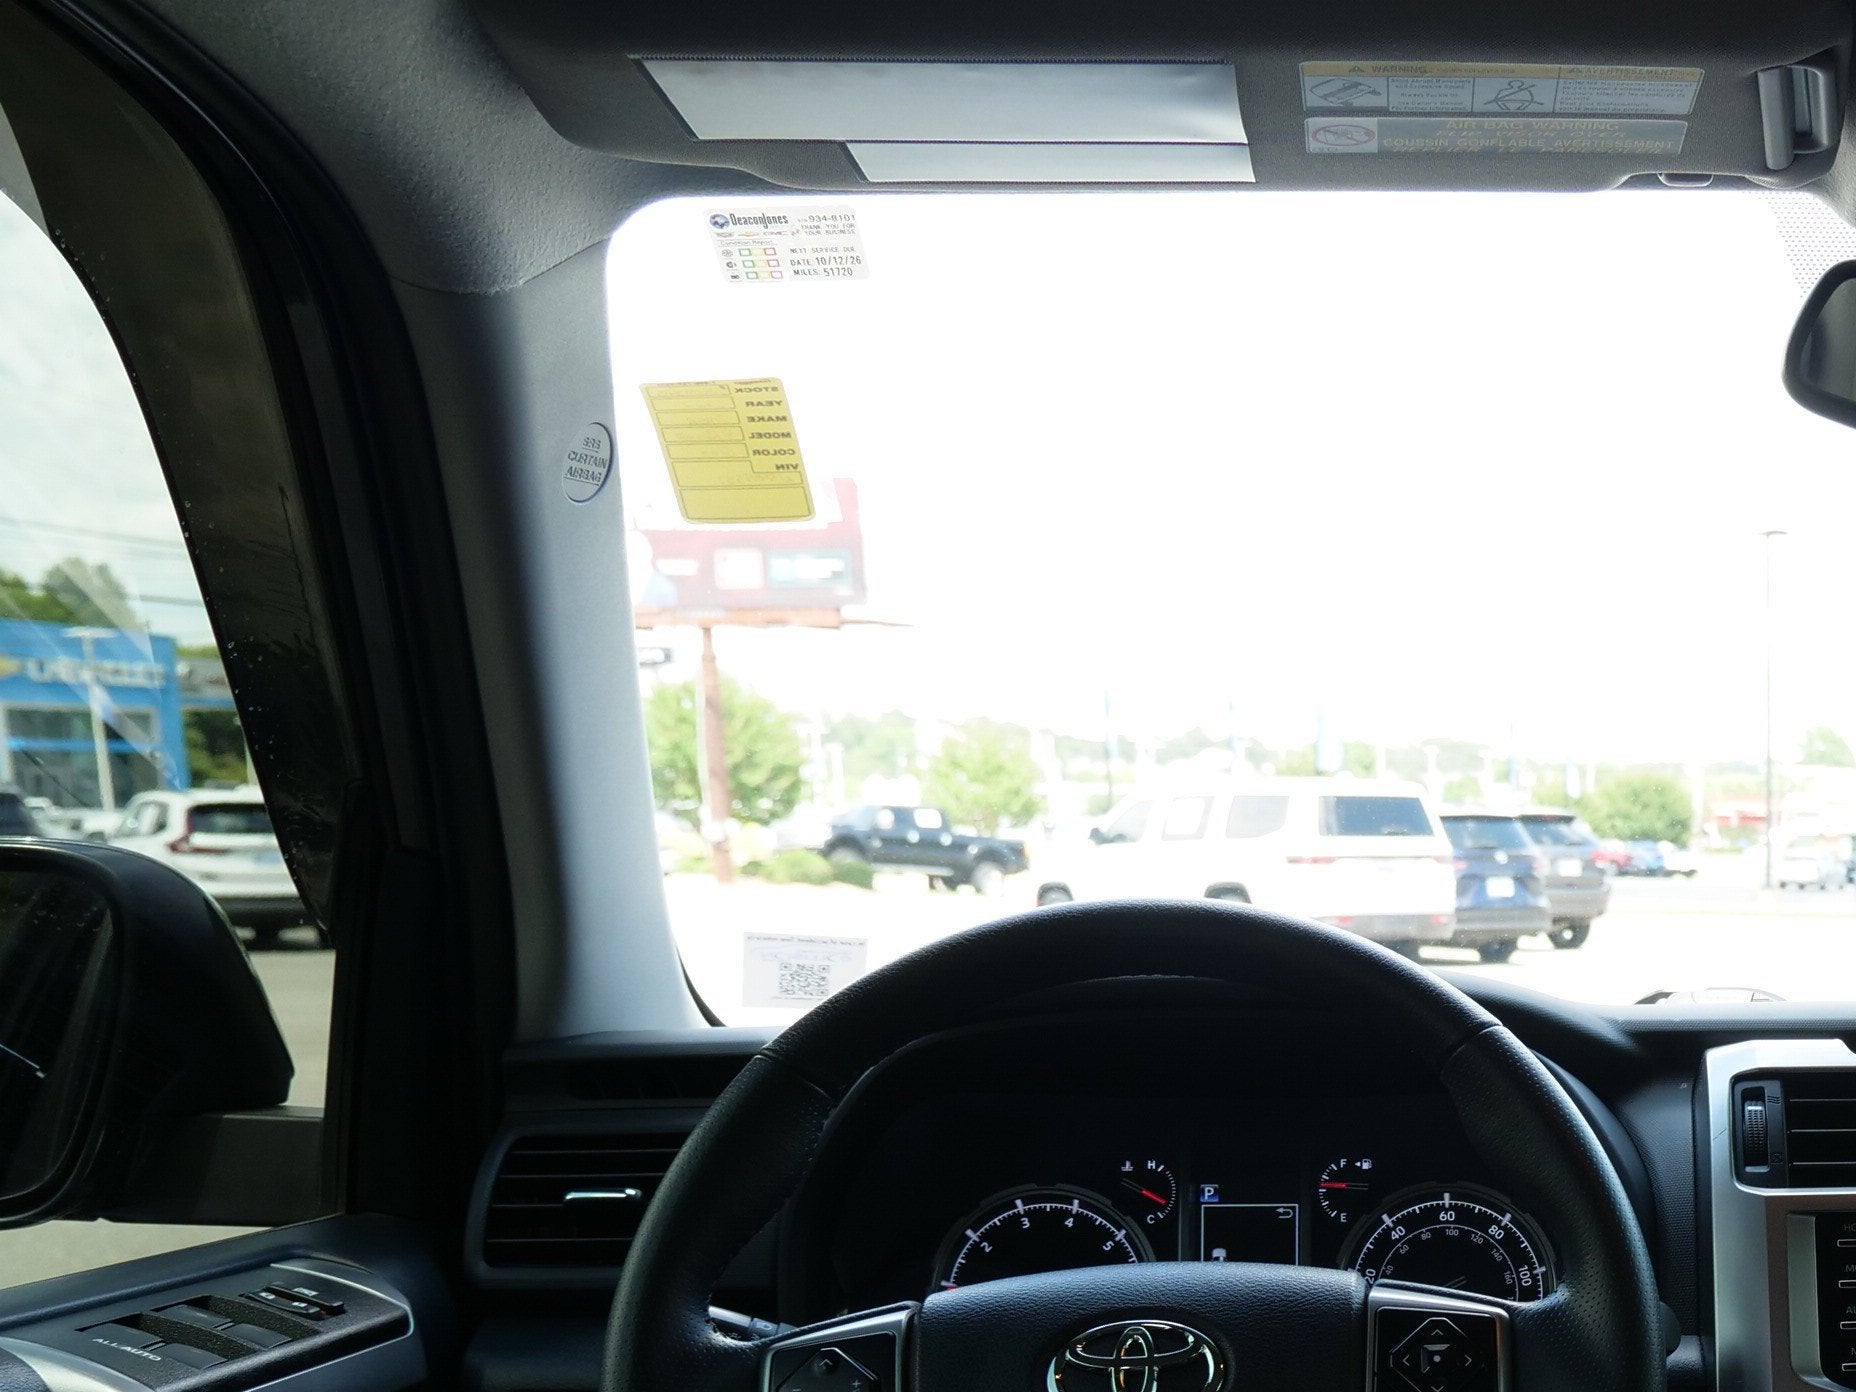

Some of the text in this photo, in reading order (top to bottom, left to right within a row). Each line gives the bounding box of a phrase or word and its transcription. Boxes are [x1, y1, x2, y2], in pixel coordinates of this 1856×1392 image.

[1446, 121, 1620, 131] AIR BAG WARNING
[1384, 138, 1674, 149] COUSSIN GONFLABLE AVERTISSEMENT
[808, 214, 856, 222] 934-8101
[815, 255, 862, 265] 10/12/26
[822, 267, 854, 277] 51720
[568, 450, 608, 469] CURTAIN
[566, 466, 602, 483] AIRBAG
[1147, 1160, 1156, 1170] H
[1340, 1158, 1347, 1168] F
[1204, 1187, 1215, 1200] P
[1146, 1214, 1155, 1224] C
[1340, 1213, 1347, 1222] E
[1439, 1210, 1455, 1221] 60
[1020, 1217, 1031, 1229] 3
[1064, 1217, 1074, 1228] 4
[1390, 1226, 1406, 1240] 40
[1421, 1231, 1432, 1241] 80
[1445, 1228, 1459, 1236] 100
[1488, 1224, 1505, 1240] 80
[1470, 1233, 1484, 1245] 120
[980, 1241, 993, 1252] 2
[1102, 1240, 1115, 1251] 5
[1399, 1244, 1410, 1254] 60
[1490, 1249, 1503, 1262] 140
[1385, 1264, 1395, 1276] 40
[1518, 1264, 1532, 1287] 100
[1364, 1268, 1377, 1285] 20
[1503, 1271, 1514, 1285] 160
[120, 1346, 162, 1361] AUTO
